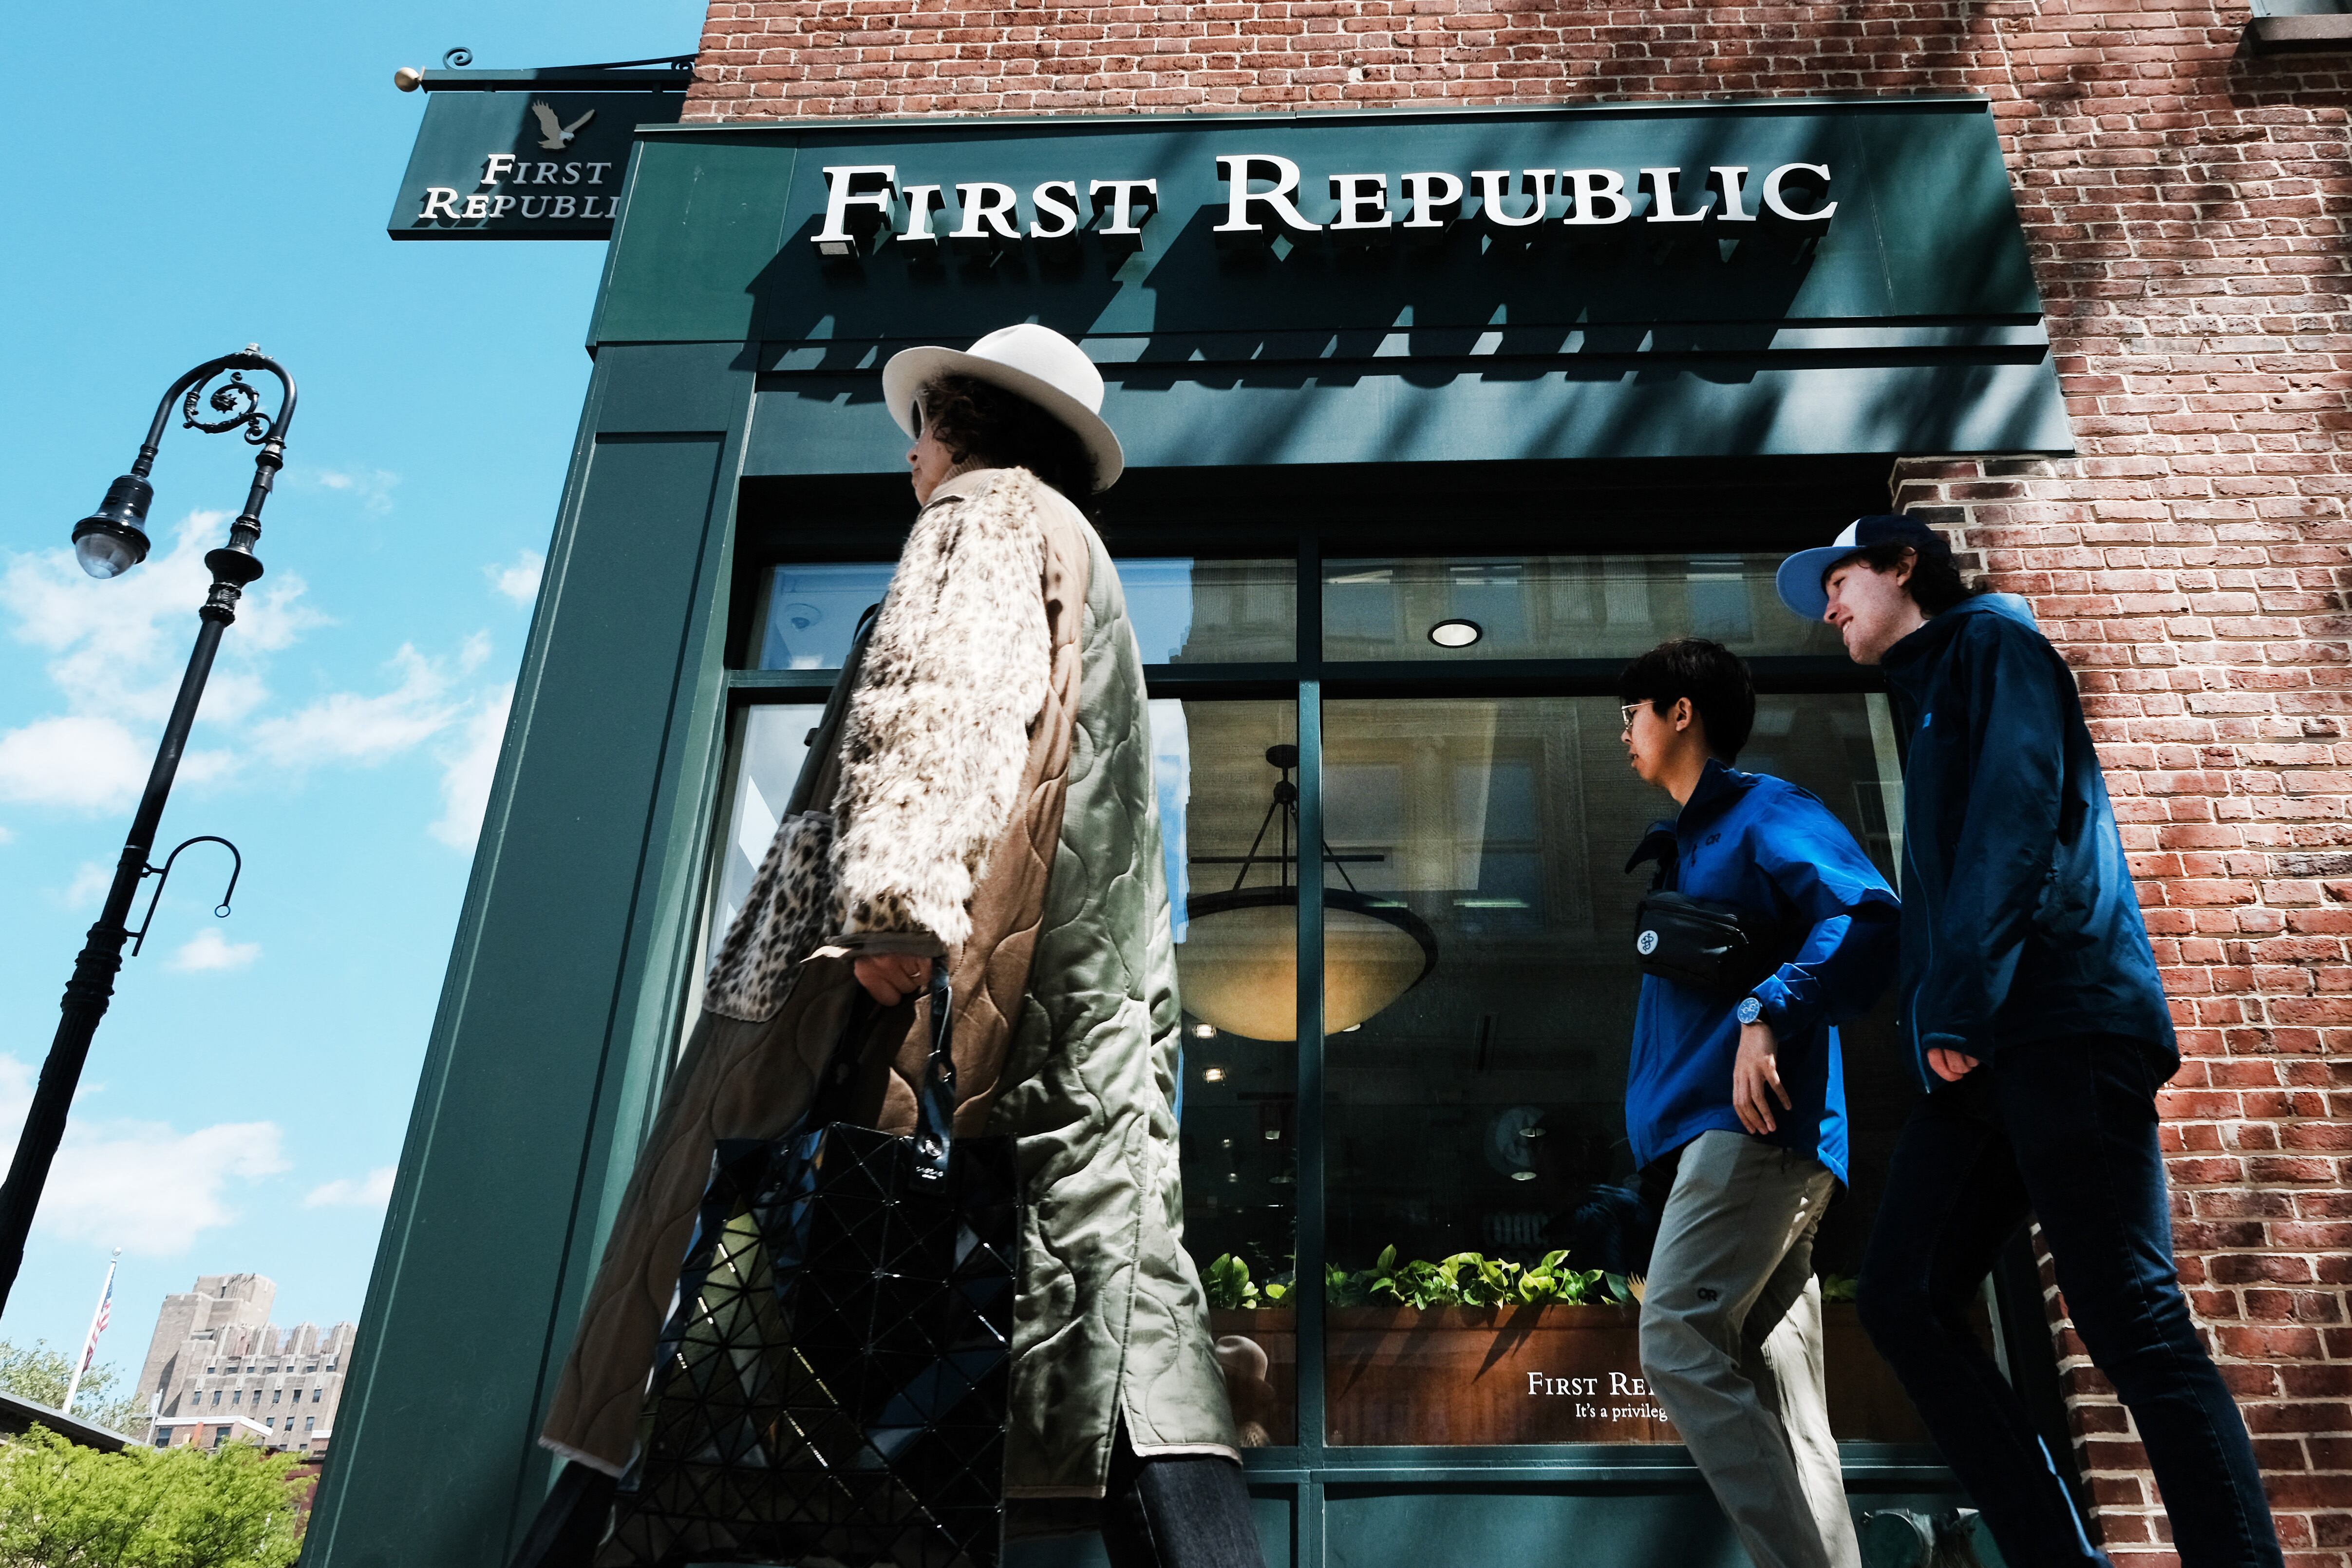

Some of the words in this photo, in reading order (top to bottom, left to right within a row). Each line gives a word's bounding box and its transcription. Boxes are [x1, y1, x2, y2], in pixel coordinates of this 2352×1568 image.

[480, 153, 612, 185] FIRST
[810, 165, 1157, 241] FIRST
[1213, 154, 1838, 231] REPUBLIC
[1697, 1287, 1717, 1302] OR
[1527, 1371, 1598, 1396] FIRST
[1576, 1403, 1595, 1417] It's
[1600, 1407, 1607, 1417] a
[1612, 1403, 1668, 1422] privileg
